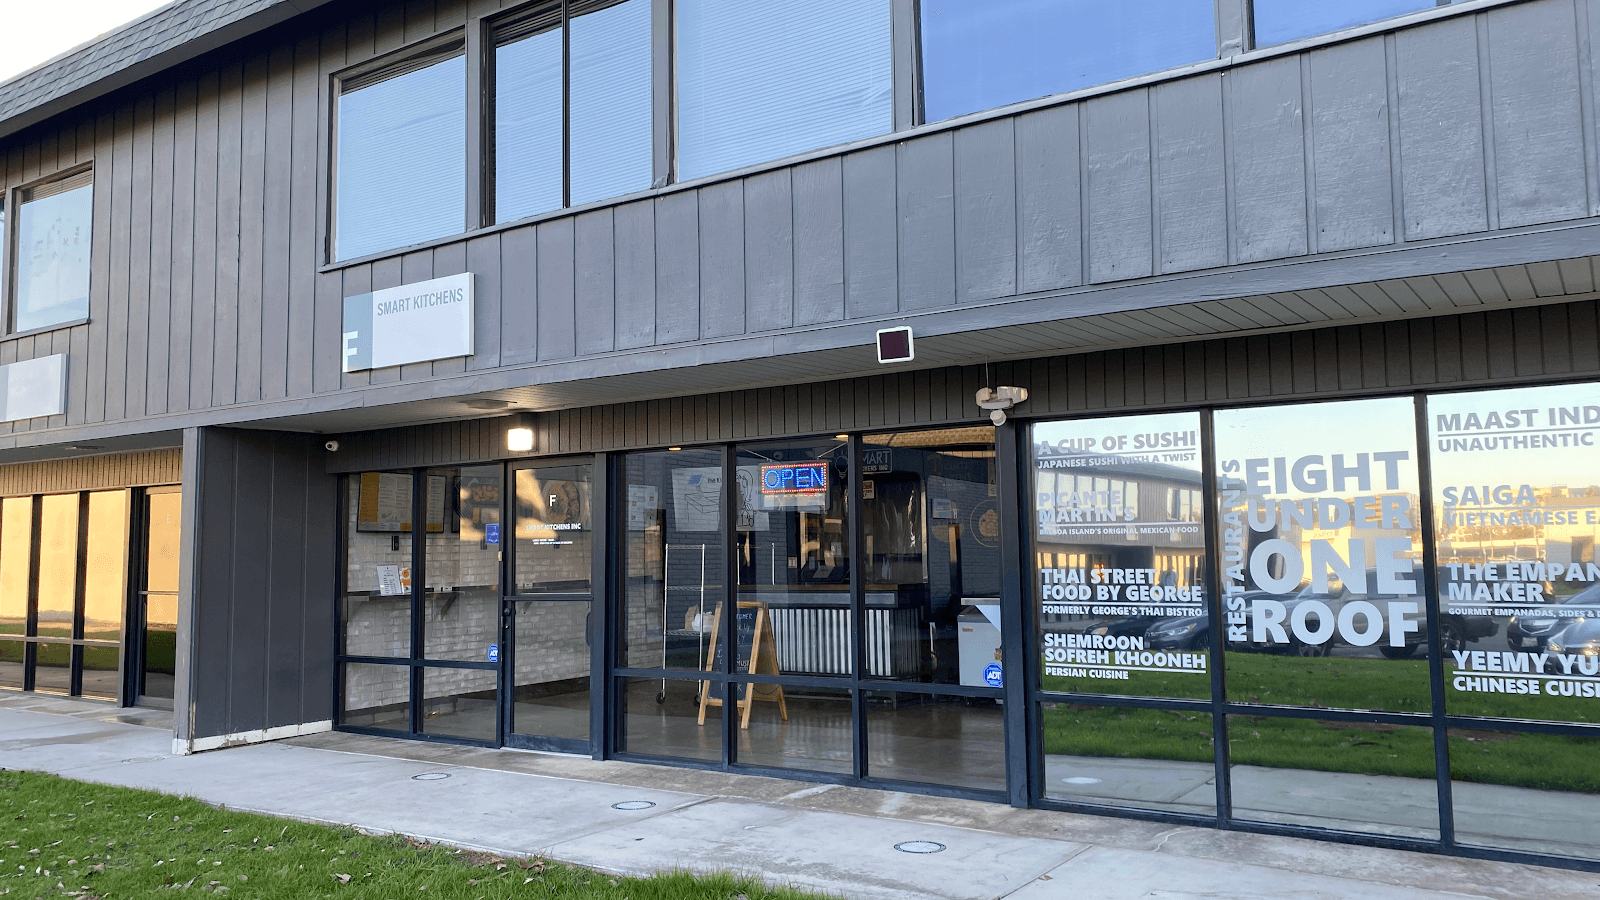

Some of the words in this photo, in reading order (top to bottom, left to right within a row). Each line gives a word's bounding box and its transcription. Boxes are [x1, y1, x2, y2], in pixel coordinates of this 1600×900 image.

[377, 298, 410, 316] SMART
[413, 288, 463, 309] KITCHENS
[1436, 408, 1539, 432] MAAST
[1548, 405, 1600, 426] IND
[1038, 440, 1052, 455] A
[1057, 438, 1096, 454] CUP
[1101, 435, 1128, 451] OF
[1133, 430, 1196, 449] SUSHI
[1437, 431, 1594, 453] UNAUTHENTIC
[1037, 459, 1087, 469] JAPANESE
[1088, 457, 1118, 466] SUSHI
[1119, 455, 1149, 465] WITH
[1152, 454, 1160, 463] A
[1162, 452, 1196, 463] TWIST
[763, 467, 825, 489] OPEN
[1246, 450, 1409, 495] EIGHT
[549, 494, 557, 507] F
[1038, 490, 1121, 507] PICANTE
[1442, 484, 1537, 507] SAIGA
[1038, 506, 1135, 523] MARTIN'S
[1247, 495, 1413, 533] UNDER
[1443, 510, 1578, 527] VIETNAMESE
[1069, 527, 1101, 535] ISLAND'S
[1103, 527, 1138, 535] ORIGINAL
[1140, 526, 1175, 534] MEXICAN
[1177, 525, 1199, 534] FOOD
[1222, 459, 1248, 642] RESTAURANTS
[1042, 568, 1085, 584] THAI
[1090, 568, 1156, 584] STREET
[1250, 538, 1417, 595] ONE
[1446, 562, 1498, 581] THE
[1043, 585, 1091, 601] FOOD
[1097, 585, 1119, 601] BY
[1126, 585, 1202, 602] GEORGE
[1447, 582, 1545, 602] MAKER
[1042, 605, 1090, 615] FORMERLY
[1091, 606, 1138, 616] GEORGE'S
[1139, 606, 1164, 616] THAI
[1166, 606, 1203, 617] BISTRO
[1448, 608, 1493, 616] GOURMET
[1494, 608, 1557, 618] EMPANADAS,
[1558, 609, 1585, 618] SIDES
[1586, 609, 1595, 617] &
[1251, 600, 1419, 648] ROOF
[1044, 633, 1144, 650] SHEMROON
[1044, 649, 1110, 665] SOFREH
[1115, 650, 1206, 669] KHOONEH
[1451, 650, 1549, 674] YEEMY
[1557, 653, 1599, 676] YU
[987, 671, 1002, 680] ADT
[1045, 667, 1087, 678] PERSIAN
[1088, 668, 1129, 680] CUISINE
[1452, 676, 1541, 695] CHINESE
[1545, 680, 1600, 698] CUISI
